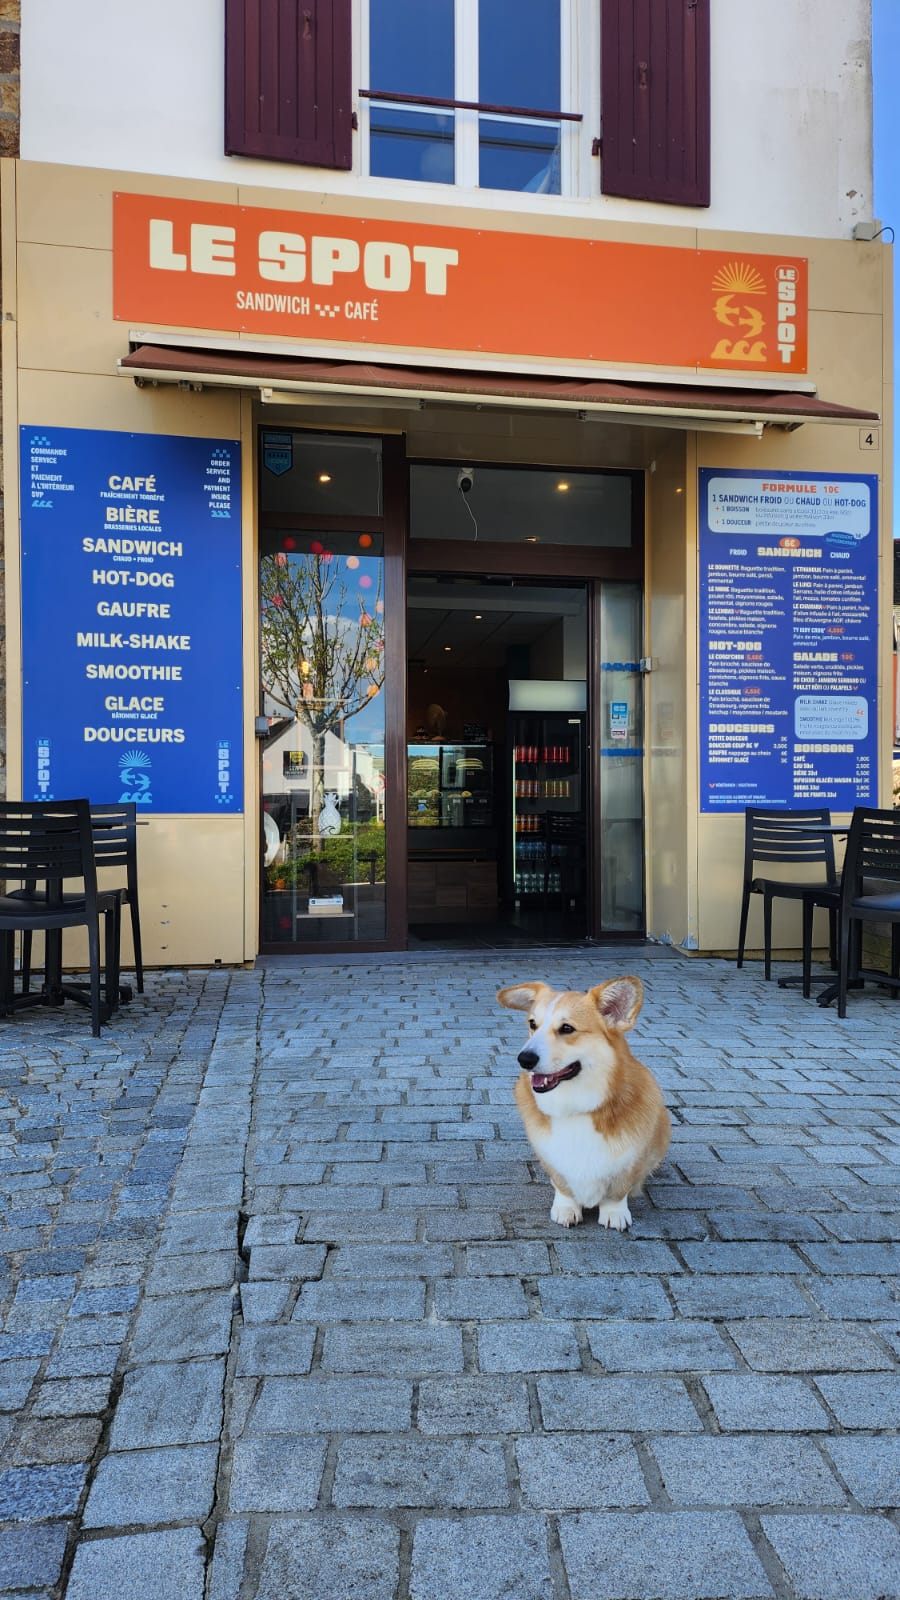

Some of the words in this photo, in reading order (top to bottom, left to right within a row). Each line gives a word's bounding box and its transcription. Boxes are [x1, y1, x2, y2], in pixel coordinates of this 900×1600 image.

[149, 219, 236, 276] LE
[258, 231, 459, 296] SPOT
[778, 268, 796, 280] LE
[236, 290, 310, 316] SANDWICH
[344, 298, 379, 321] CAFÉ
[777, 282, 796, 363] SPOT
[866, 433, 873, 445] 4
[31, 448, 67, 456] COMMANDE
[31, 474, 62, 482] PAIEMENT
[109, 475, 156, 492] CAFÉ
[762, 483, 817, 493] FORMULE
[211, 493, 231, 501] INSIDE
[719, 495, 758, 503] SANDWICH
[760, 496, 782, 504] FROID
[835, 499, 866, 507] HOT-DOG
[106, 505, 160, 524] BIÈRE
[82, 538, 183, 556] SANDWICH
[757, 547, 822, 558] SANDWICH
[92, 570, 174, 587] HOT-DOG
[97, 602, 170, 618] GAUFRE
[76, 633, 191, 650] MILK-SHAKE
[709, 641, 762, 650] HOT-DOG
[793, 652, 838, 661] SALADE
[86, 665, 182, 680] SMOOTHIE
[105, 696, 164, 712] GLACE
[84, 728, 185, 743] DOUCEURS
[709, 724, 774, 733] DOUCEURS
[794, 744, 854, 752] BOISSONS
[38, 747, 50, 792] SPOT
[219, 749, 229, 793] SPOT
